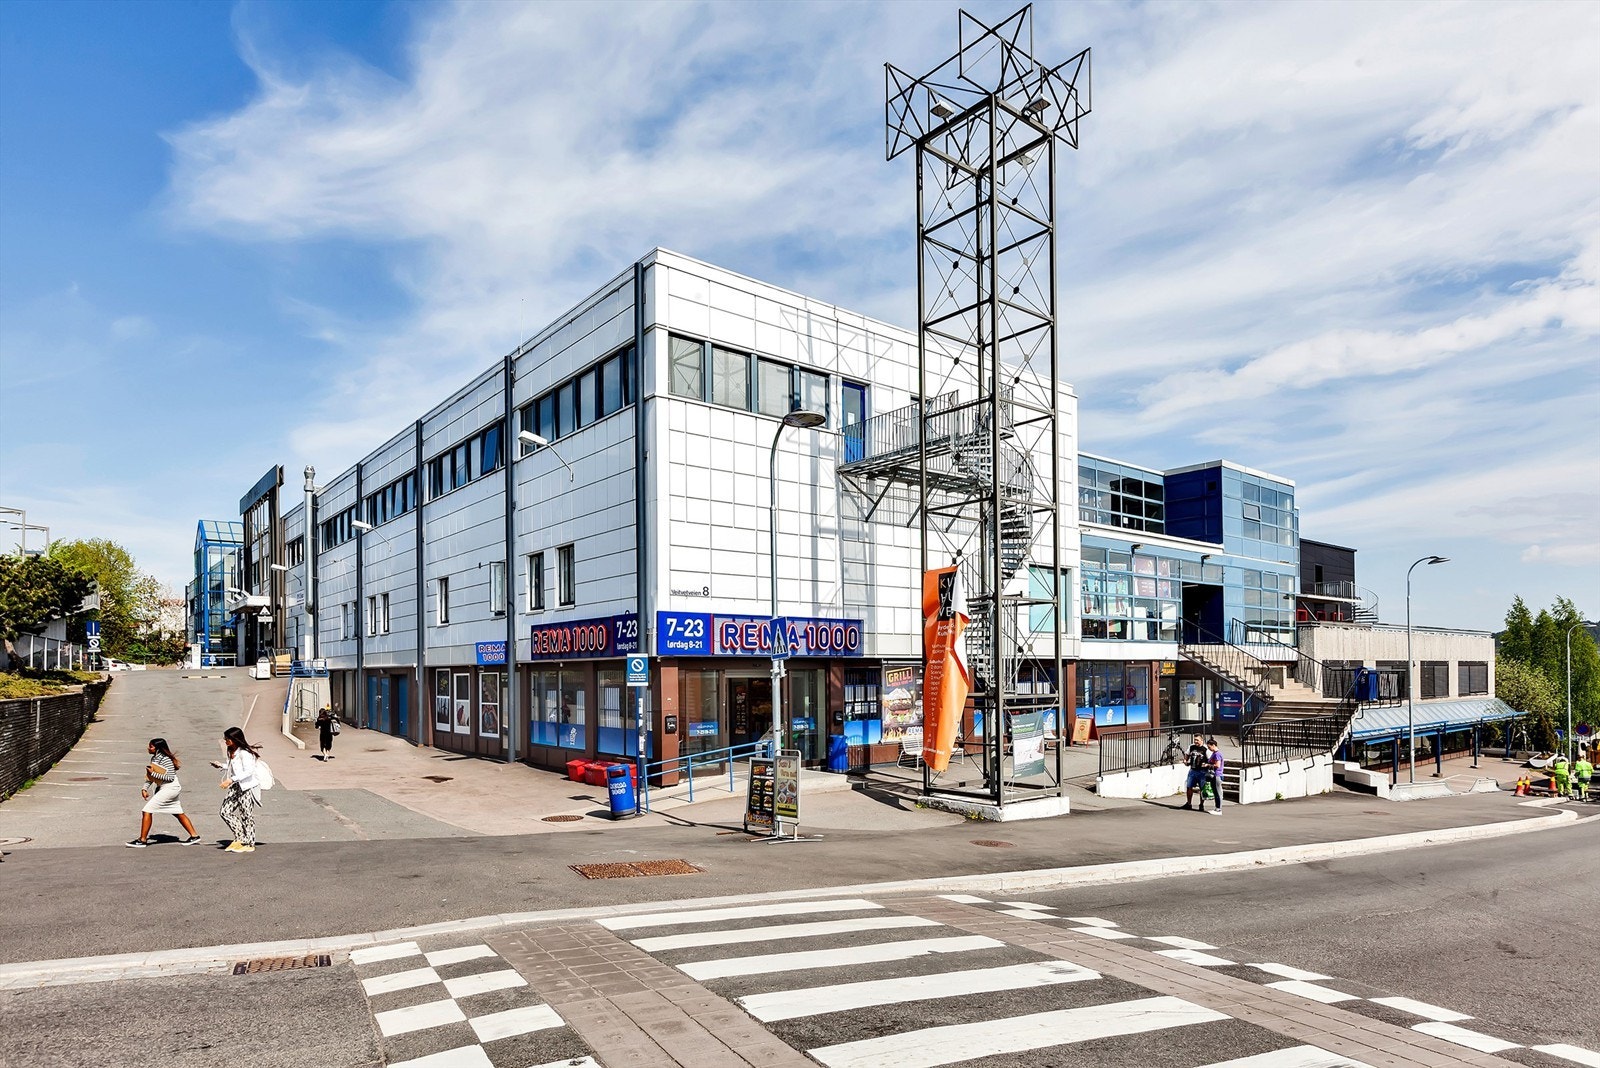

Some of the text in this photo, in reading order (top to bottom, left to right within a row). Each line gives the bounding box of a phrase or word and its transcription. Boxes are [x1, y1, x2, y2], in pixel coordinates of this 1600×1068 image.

[702, 586, 709, 597] 8
[616, 619, 638, 639] 7-23
[666, 617, 704, 638] 7-23
[532, 624, 608, 654] REMA 1000
[689, 640, 703, 649] 8-21
[806, 624, 860, 650] 1000
[478, 643, 506, 653] REMA
[482, 653, 505, 662] 1000
[888, 669, 911, 684] GRILL
